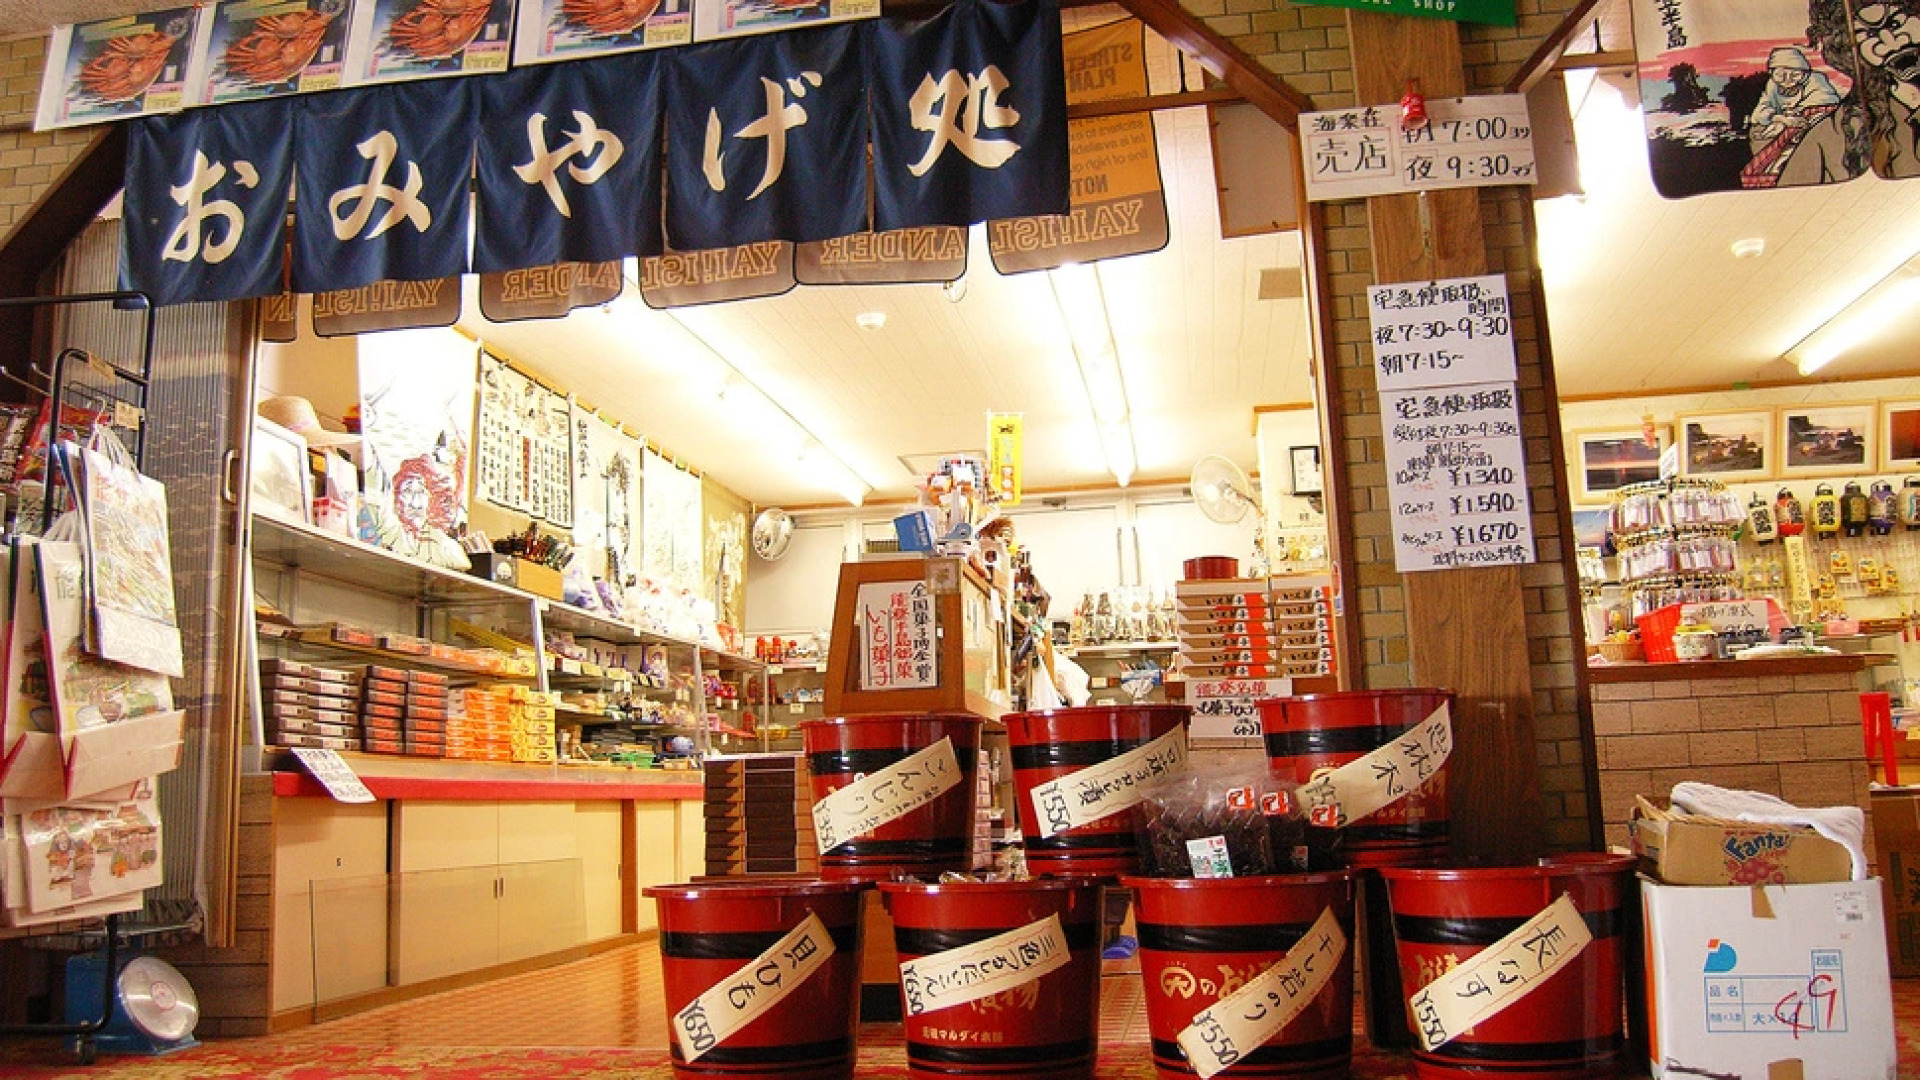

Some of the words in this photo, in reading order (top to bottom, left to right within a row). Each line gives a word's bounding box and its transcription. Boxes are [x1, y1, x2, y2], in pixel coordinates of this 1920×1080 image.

[162, 64, 1022, 264] おみやげ処
[1316, 135, 1387, 175] 売店
[1406, 155, 1438, 181] 夜
[727, 934, 818, 1010] 貝ひも
[1455, 924, 1566, 1001] 長なす
[678, 998, 717, 1052] ¥650
[1192, 1010, 1240, 1066] ¥550
